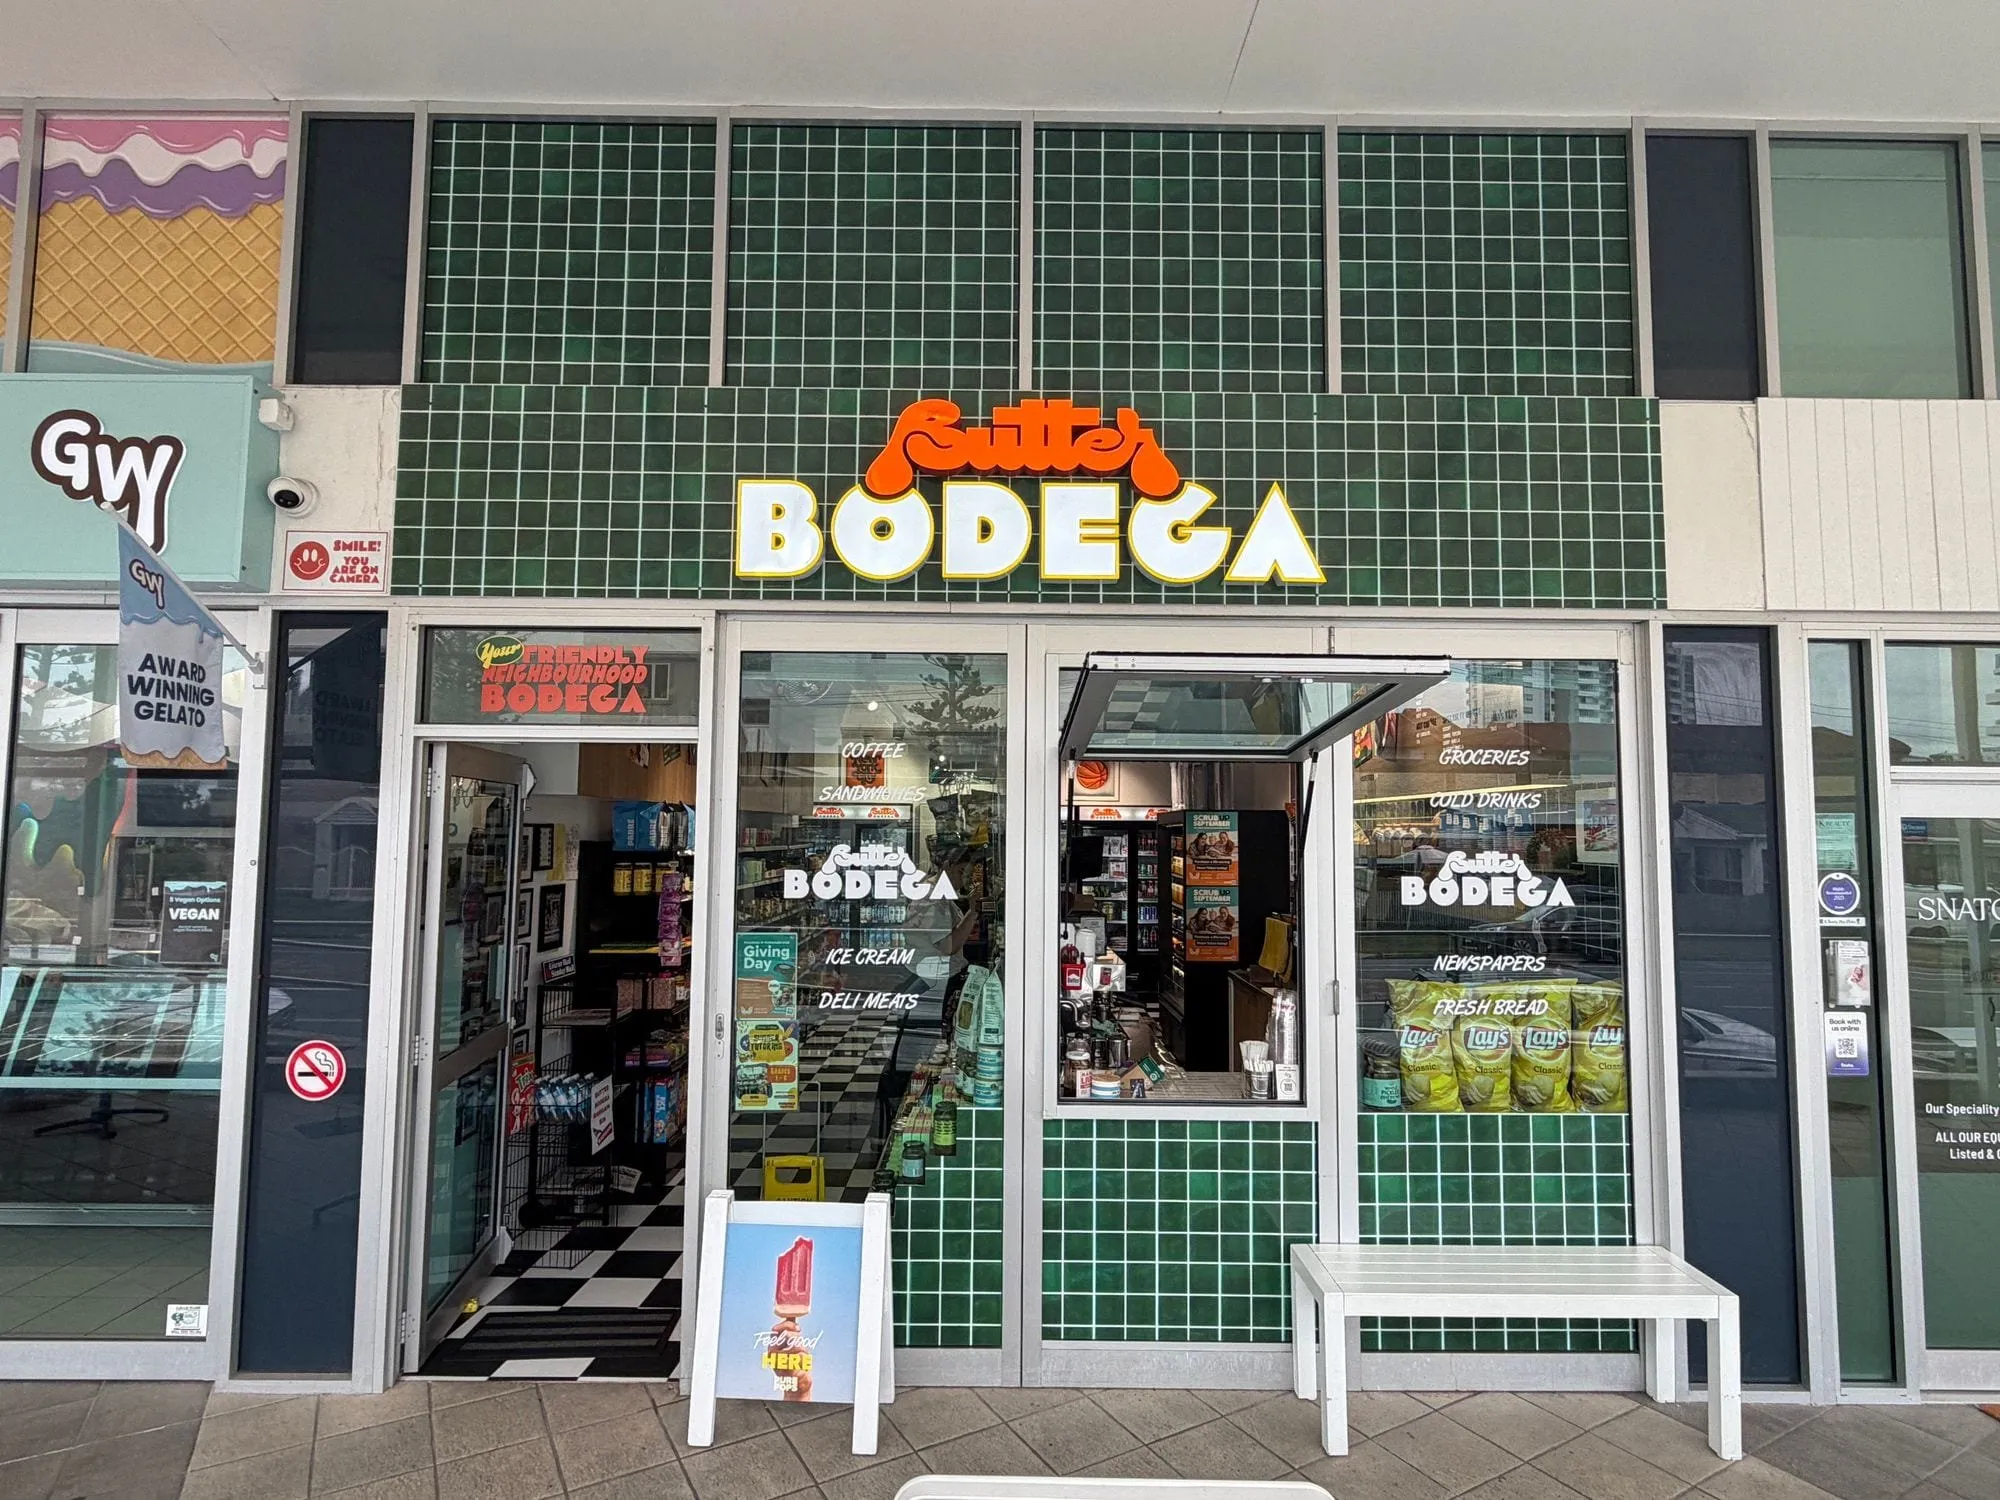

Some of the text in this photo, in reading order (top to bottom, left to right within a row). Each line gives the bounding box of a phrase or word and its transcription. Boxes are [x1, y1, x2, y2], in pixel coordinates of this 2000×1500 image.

[865, 398, 1180, 497] Butter
[735, 480, 1328, 586] BODEGA
[333, 540, 381, 552] SMILE!
[343, 556, 369, 565] YOU
[329, 574, 379, 583] CAMERA
[332, 566, 379, 574] ARE ON
[481, 642, 649, 669] Your FRIENDLY
[138, 653, 206, 683] AWARD
[480, 663, 648, 684] NEIGHBOURHOOD
[127, 674, 215, 706] WINNING
[480, 684, 647, 713] BODEGA
[134, 700, 206, 727] GELATO
[842, 742, 906, 758] COFFEE
[1439, 750, 1531, 766] GROCERIES
[819, 785, 926, 801] SANDWICHES
[1429, 792, 1542, 809] COLD DRINKS
[822, 844, 916, 875] Butter
[1438, 850, 1532, 881] Butter
[783, 870, 958, 900] BODEGA
[1401, 877, 1575, 907] BODEGA
[169, 908, 220, 920] VEGAN
[744, 945, 790, 960] Giving
[825, 948, 915, 965] ICE CREAM
[744, 957, 772, 972] Day
[1433, 955, 1547, 972] NEWSPAPERS
[819, 992, 919, 1010] DELI MEATS
[1433, 999, 1548, 1016] FRESH BREAD
[1466, 1026, 1509, 1049] Lay's
[1524, 1026, 1567, 1049] Lay's
[1407, 1063, 1437, 1074] Classic
[1475, 1065, 1503, 1074] Classic
[1533, 1065, 1562, 1074] Classic
[1599, 1062, 1624, 1071] Class
[1925, 1103, 2000, 1117] Our Speciality
[1935, 1132, 1957, 1142] ALL
[1958, 1132, 1981, 1143] OUR
[1950, 1148, 1984, 1159] Listed
[1986, 1149, 1995, 1159] &
[753, 1330, 824, 1351] Feel good
[762, 1352, 813, 1372] HERE
